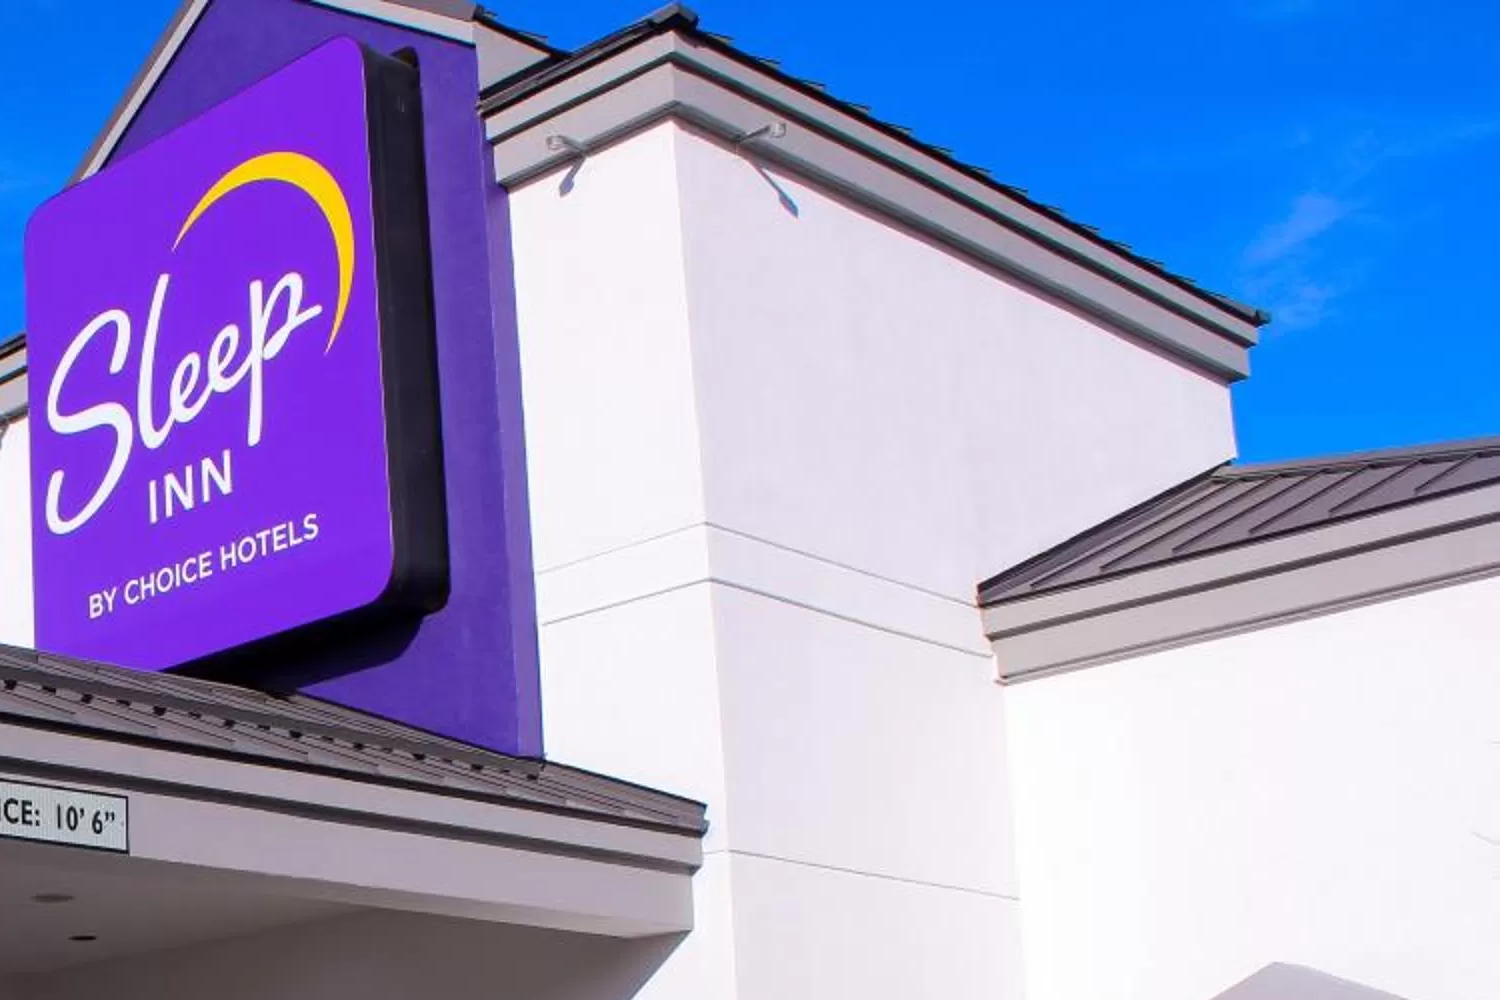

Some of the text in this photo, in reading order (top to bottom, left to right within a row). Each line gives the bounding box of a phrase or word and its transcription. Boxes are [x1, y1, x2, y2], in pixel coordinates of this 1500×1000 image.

[45, 271, 323, 535] Sleep
[148, 449, 233, 524] INN
[88, 513, 319, 619] BY CHOICE HOTELS
